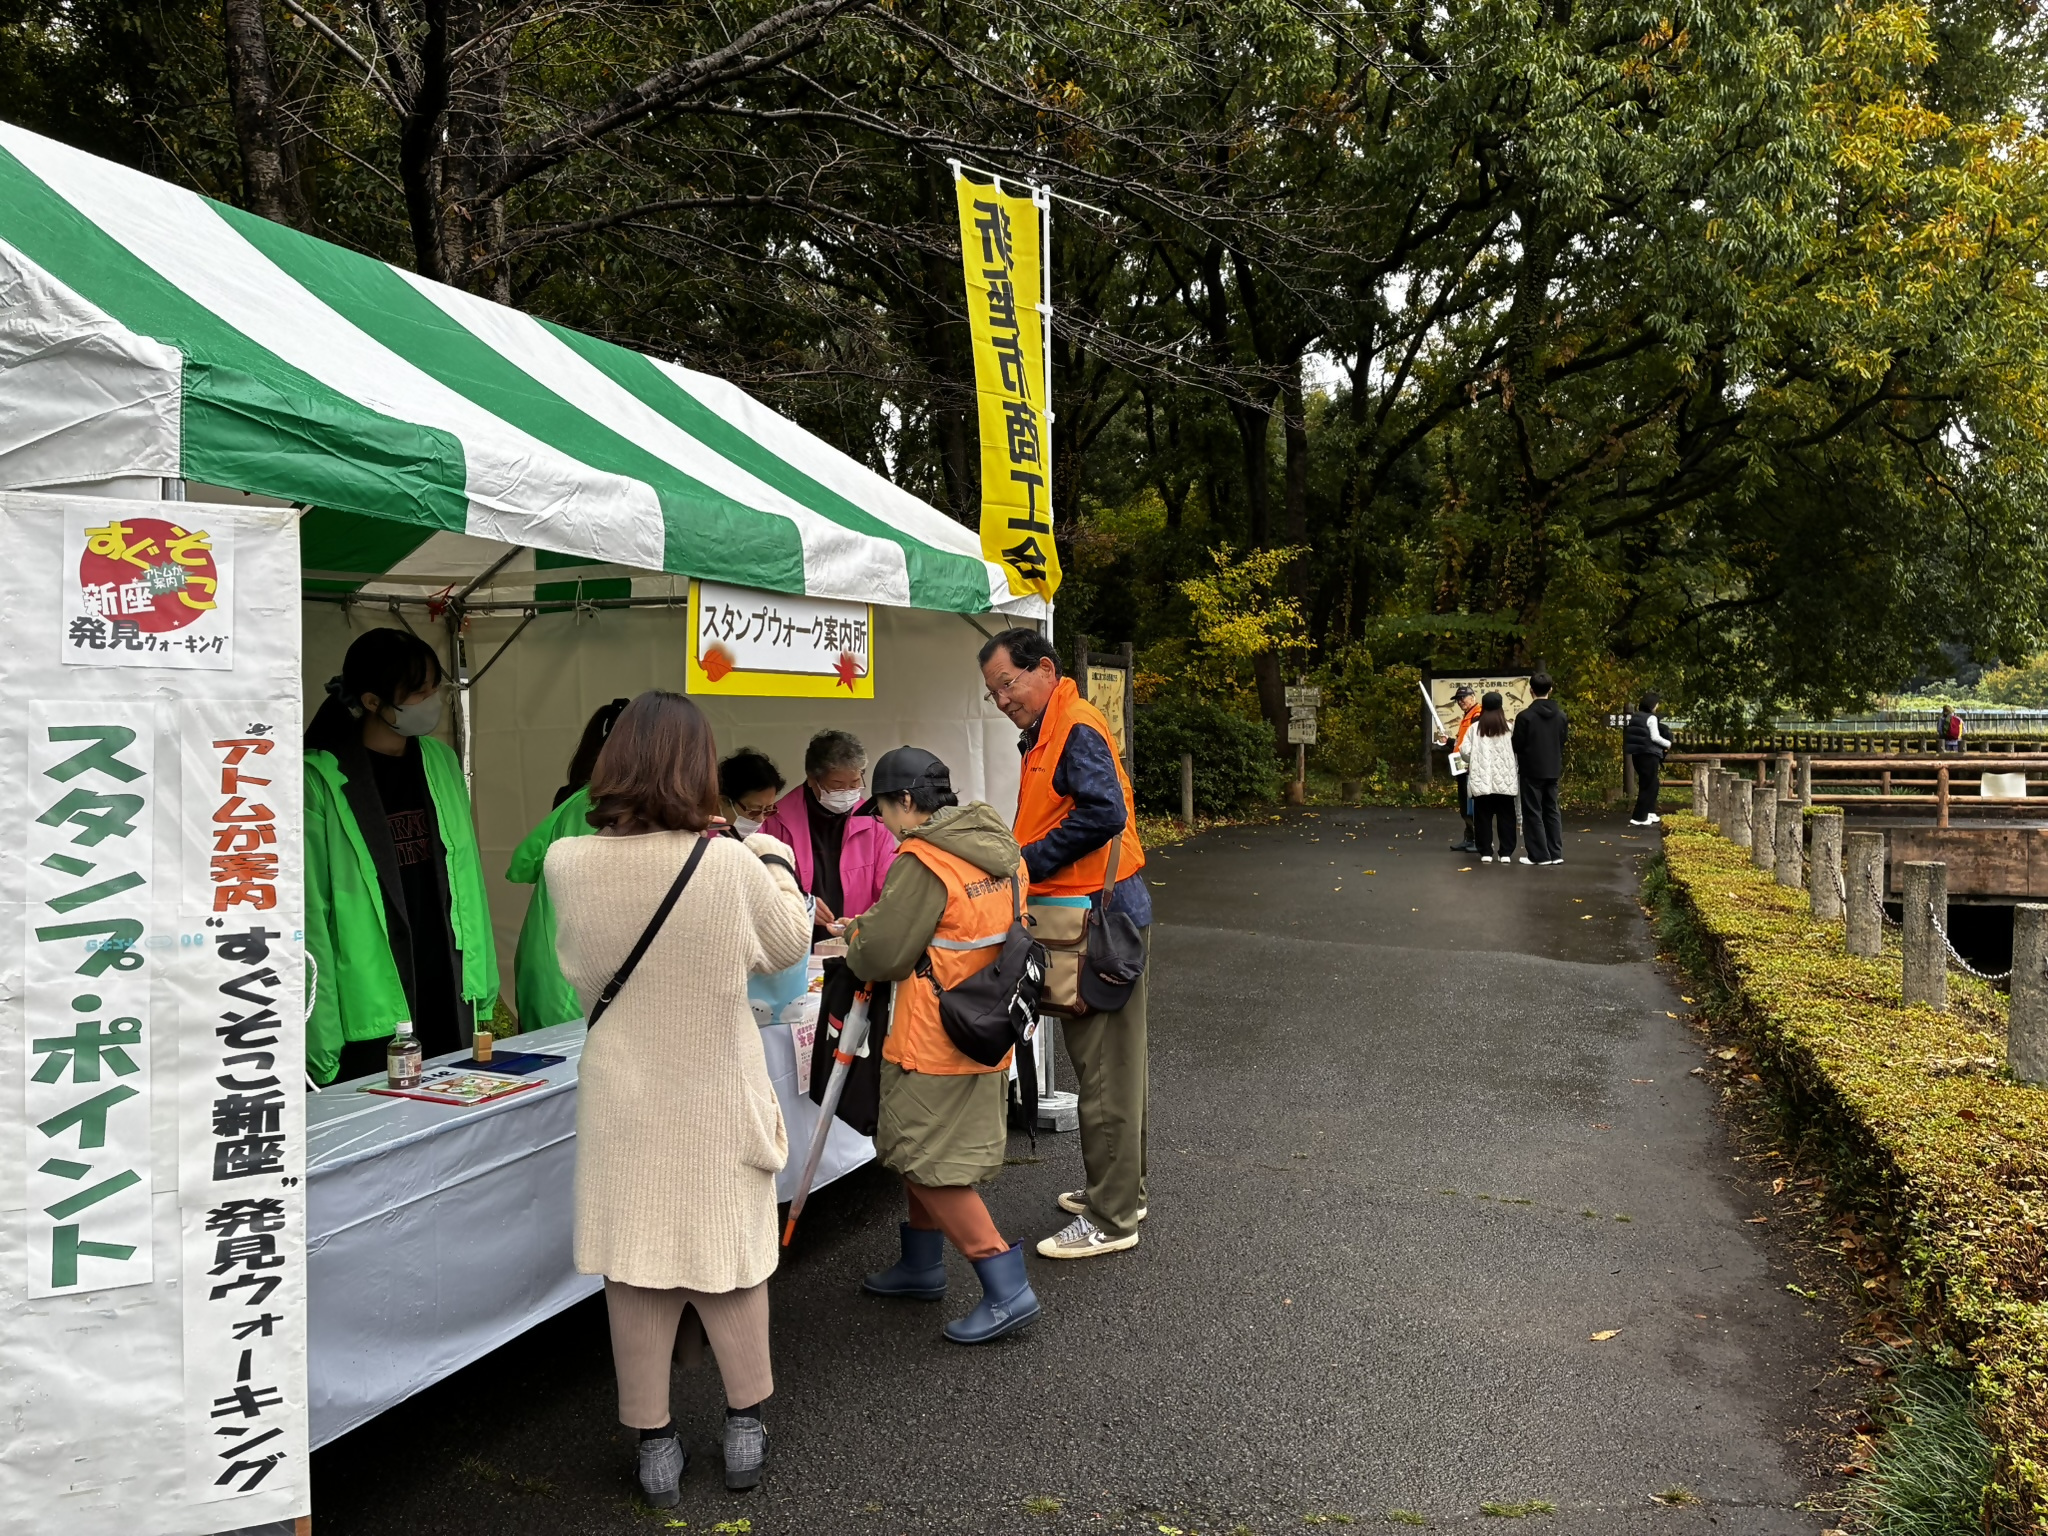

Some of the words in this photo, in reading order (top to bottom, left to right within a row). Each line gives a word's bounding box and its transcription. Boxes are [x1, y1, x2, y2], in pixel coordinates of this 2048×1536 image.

[82, 582, 156, 617] 新座
[702, 603, 867, 655] スタンプウォーク案内所
